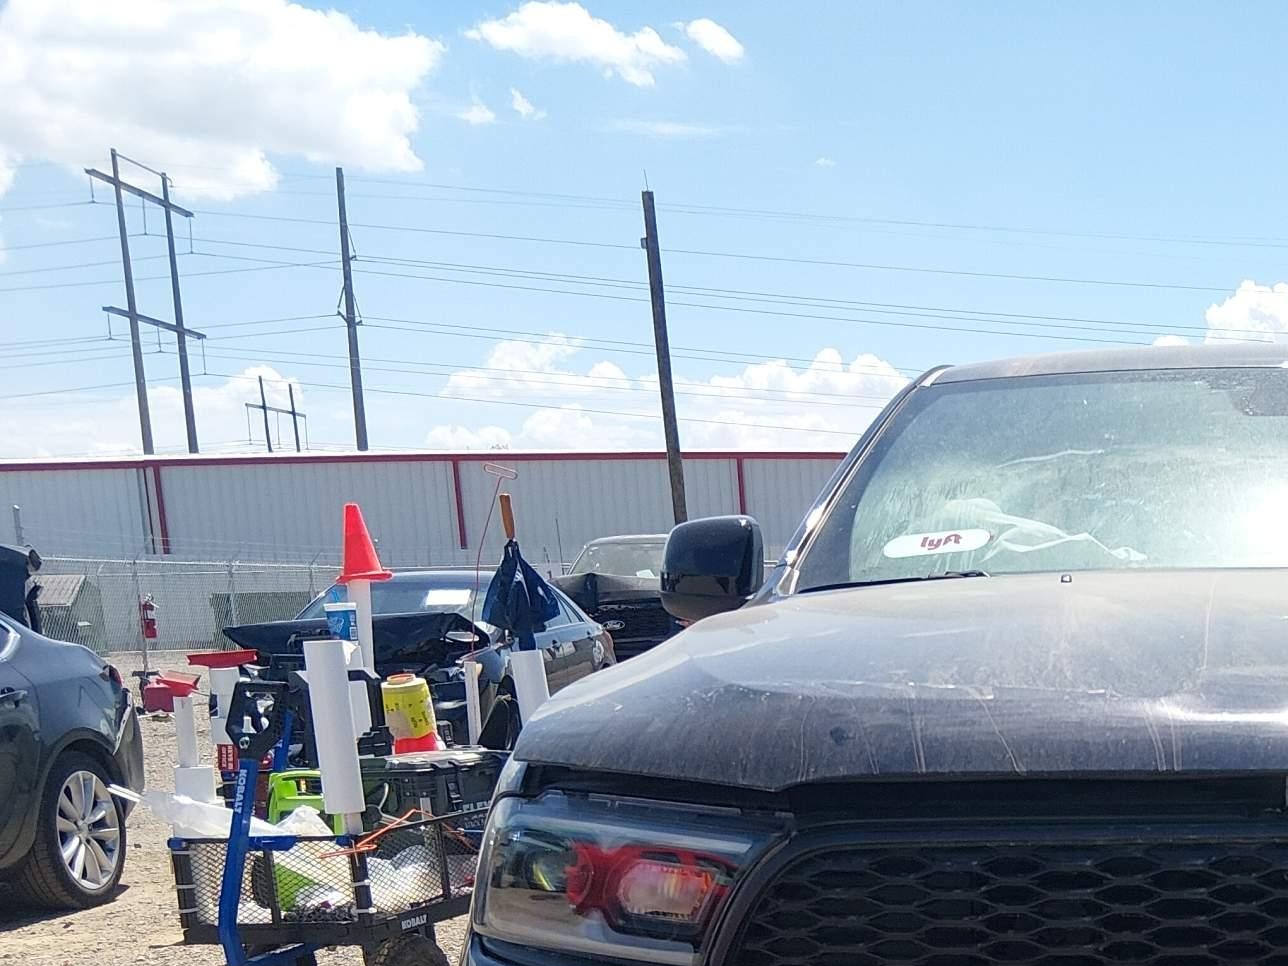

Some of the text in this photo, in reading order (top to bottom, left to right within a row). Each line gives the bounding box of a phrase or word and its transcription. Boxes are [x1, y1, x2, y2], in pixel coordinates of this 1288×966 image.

[920, 533, 963, 551] lyft
[234, 769, 248, 814] KOBALT
[401, 914, 428, 930] KOBALT
